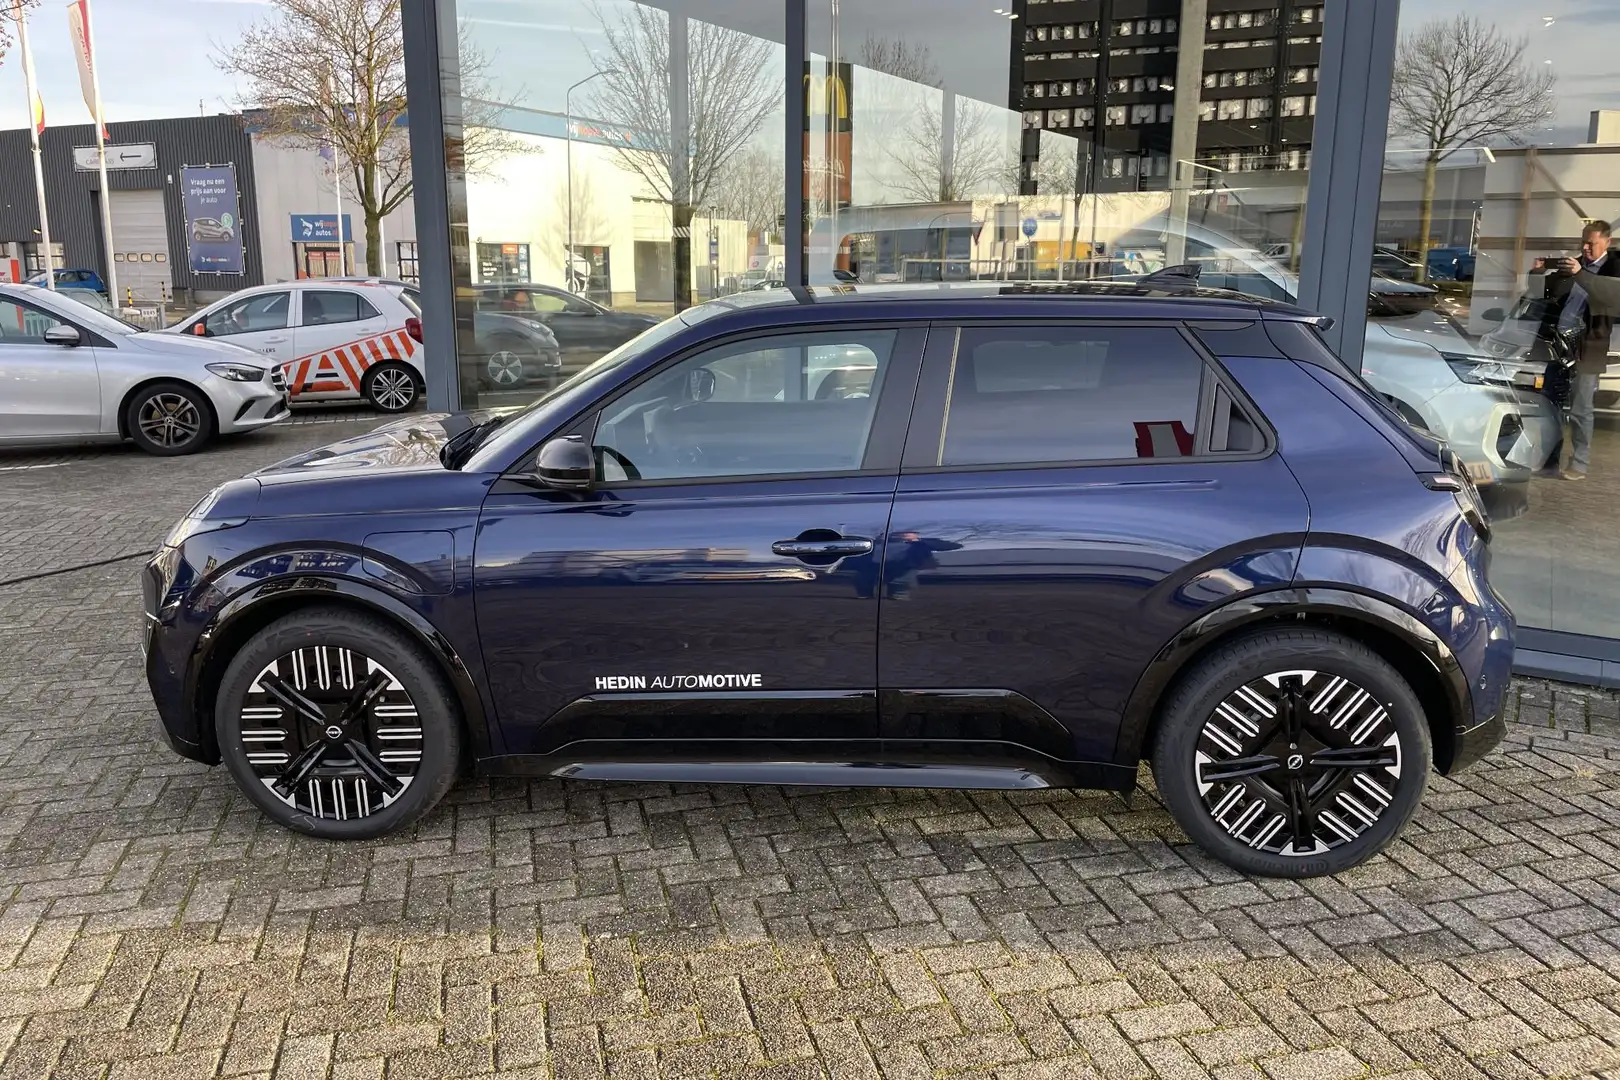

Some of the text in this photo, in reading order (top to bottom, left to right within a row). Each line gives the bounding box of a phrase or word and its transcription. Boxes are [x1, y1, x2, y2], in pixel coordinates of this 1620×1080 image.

[190, 178, 206, 187] Vraag
[190, 187, 203, 196] prijs
[595, 673, 763, 690] HEDIN AUTOMOTIVE
